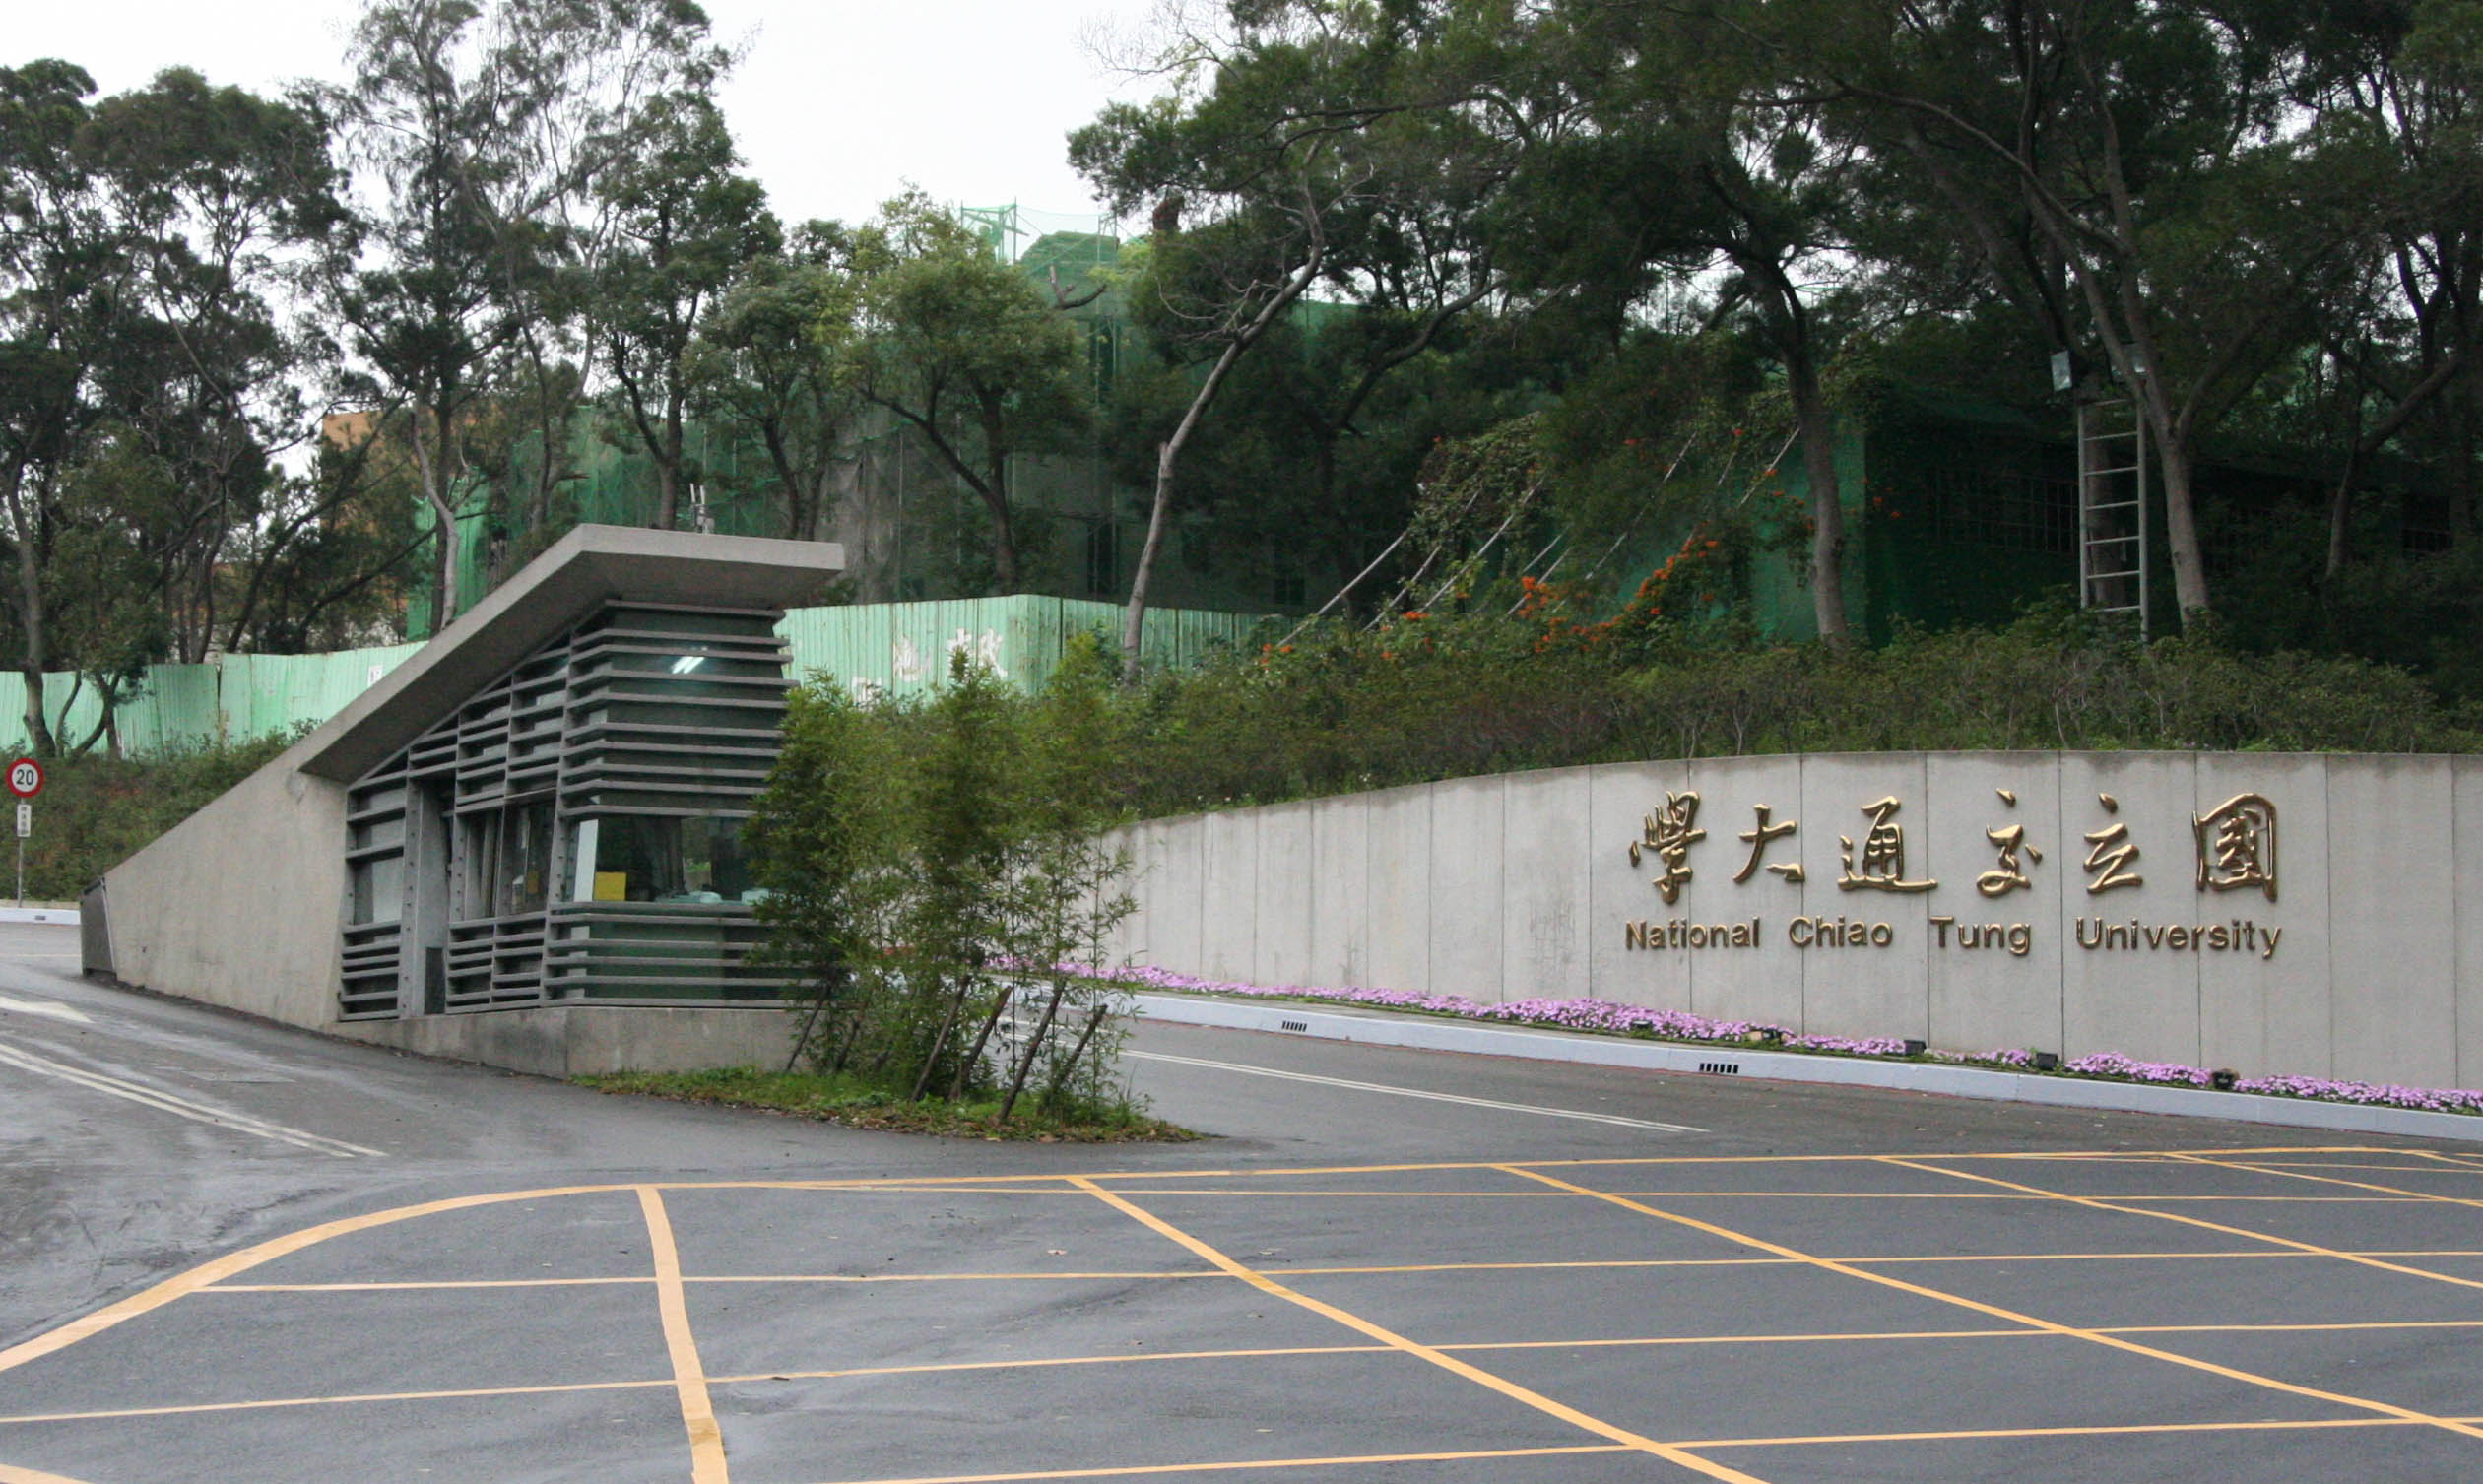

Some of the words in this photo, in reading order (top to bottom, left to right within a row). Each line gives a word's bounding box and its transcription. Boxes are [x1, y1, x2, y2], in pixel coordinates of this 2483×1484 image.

[16, 769, 34, 786] 20
[1628, 789, 2277, 904] 國立交通大學
[1625, 916, 1760, 949] National
[1788, 916, 1894, 946] Chiao
[1929, 916, 2031, 956] Tung
[2075, 916, 2282, 959] University
